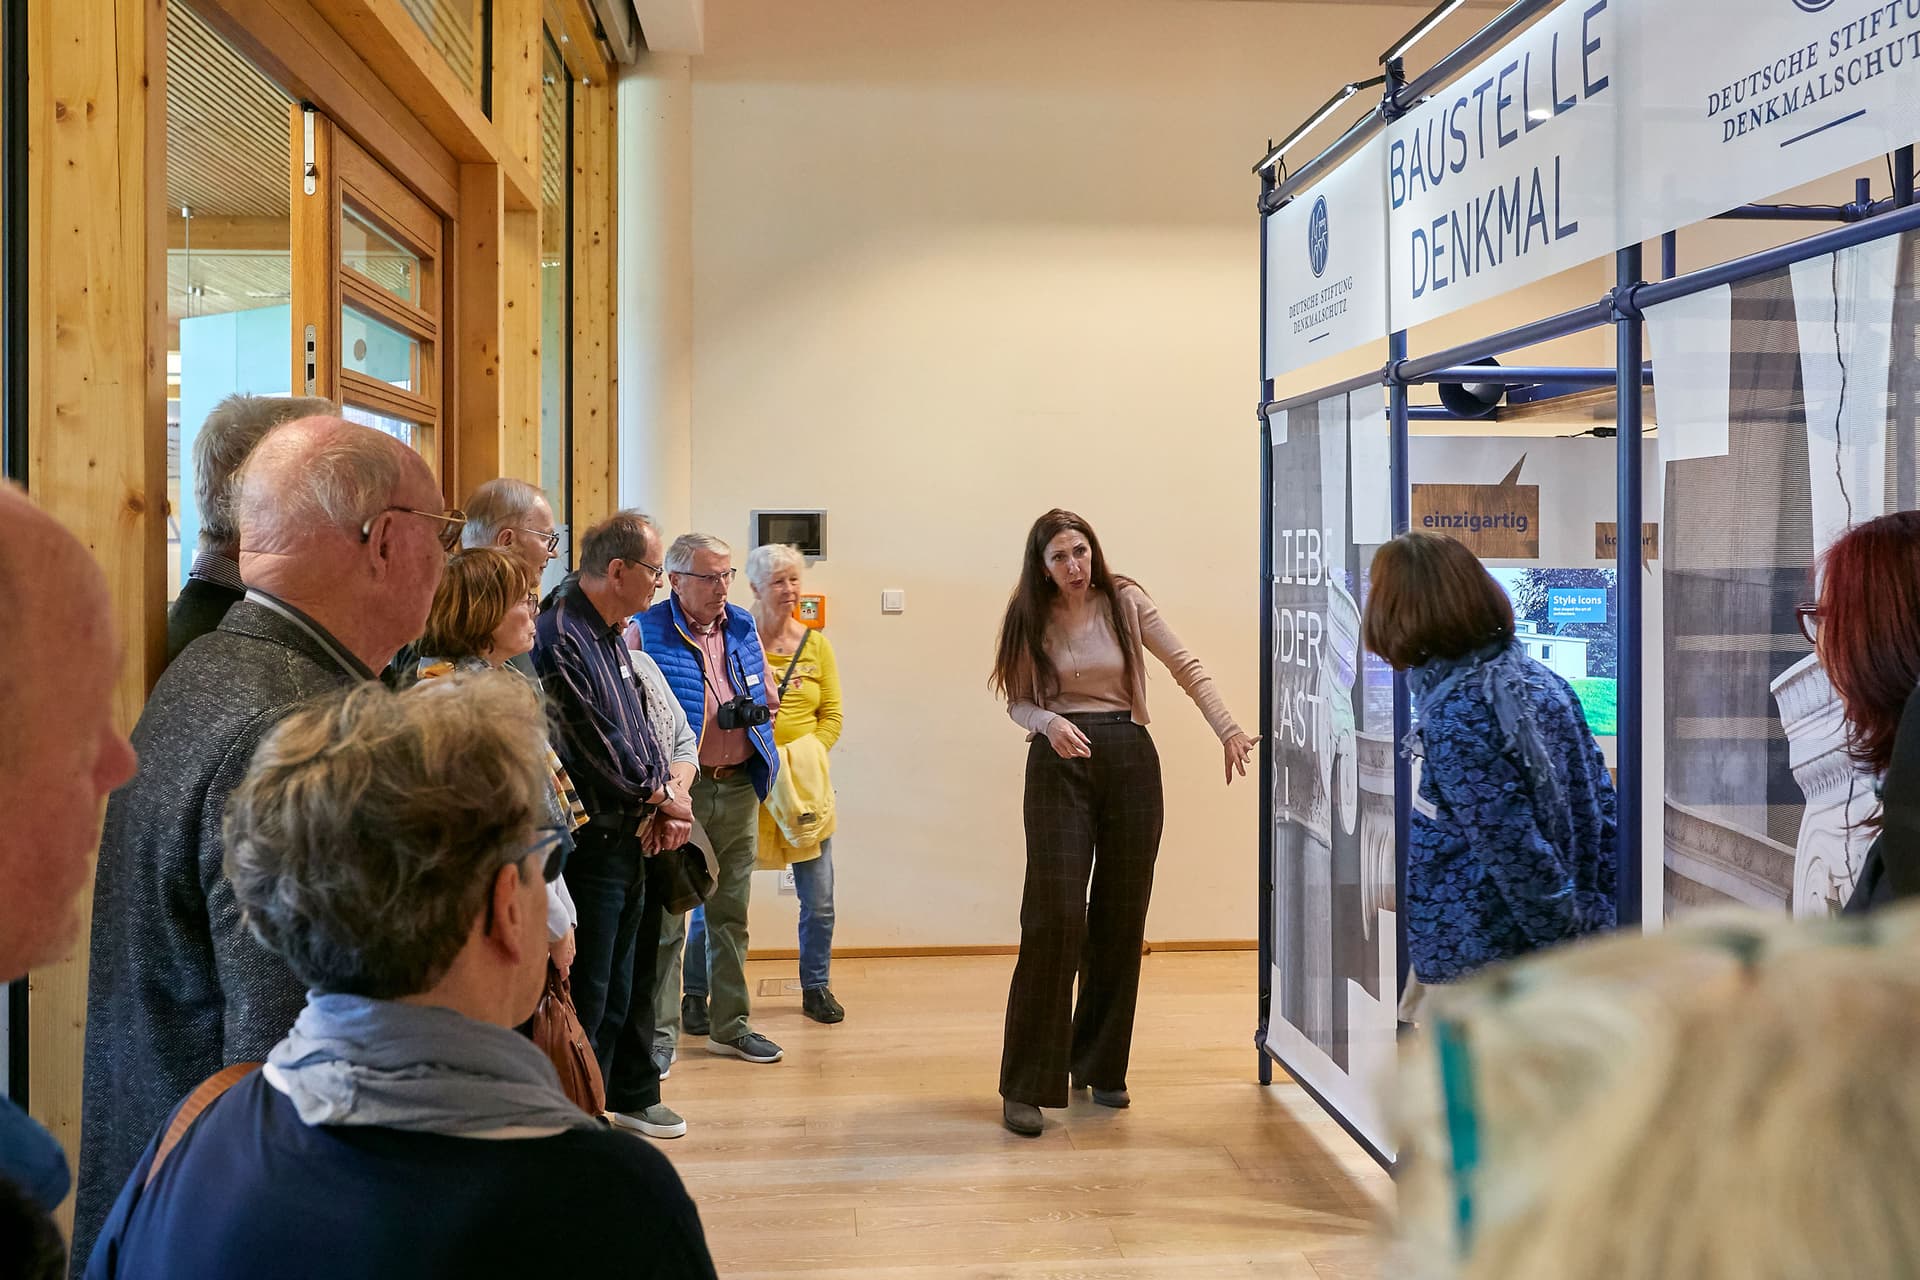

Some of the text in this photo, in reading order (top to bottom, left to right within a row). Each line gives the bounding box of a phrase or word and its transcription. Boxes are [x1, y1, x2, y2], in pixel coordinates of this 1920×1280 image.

[1391, 0, 1609, 210] BAUSTELLE
[1708, 41, 1818, 117] DEUTSCHE
[1412, 155, 1578, 300] DENKMAL
[1289, 275, 1353, 319] DEUTSCHE STIFTUNG
[1293, 298, 1347, 335] DENKMALSCHUTZ
[1423, 511, 1528, 532] einzigartig
[1274, 528, 1333, 587] IEBE
[1553, 595, 1577, 606] Style
[1274, 687, 1321, 752] AST
